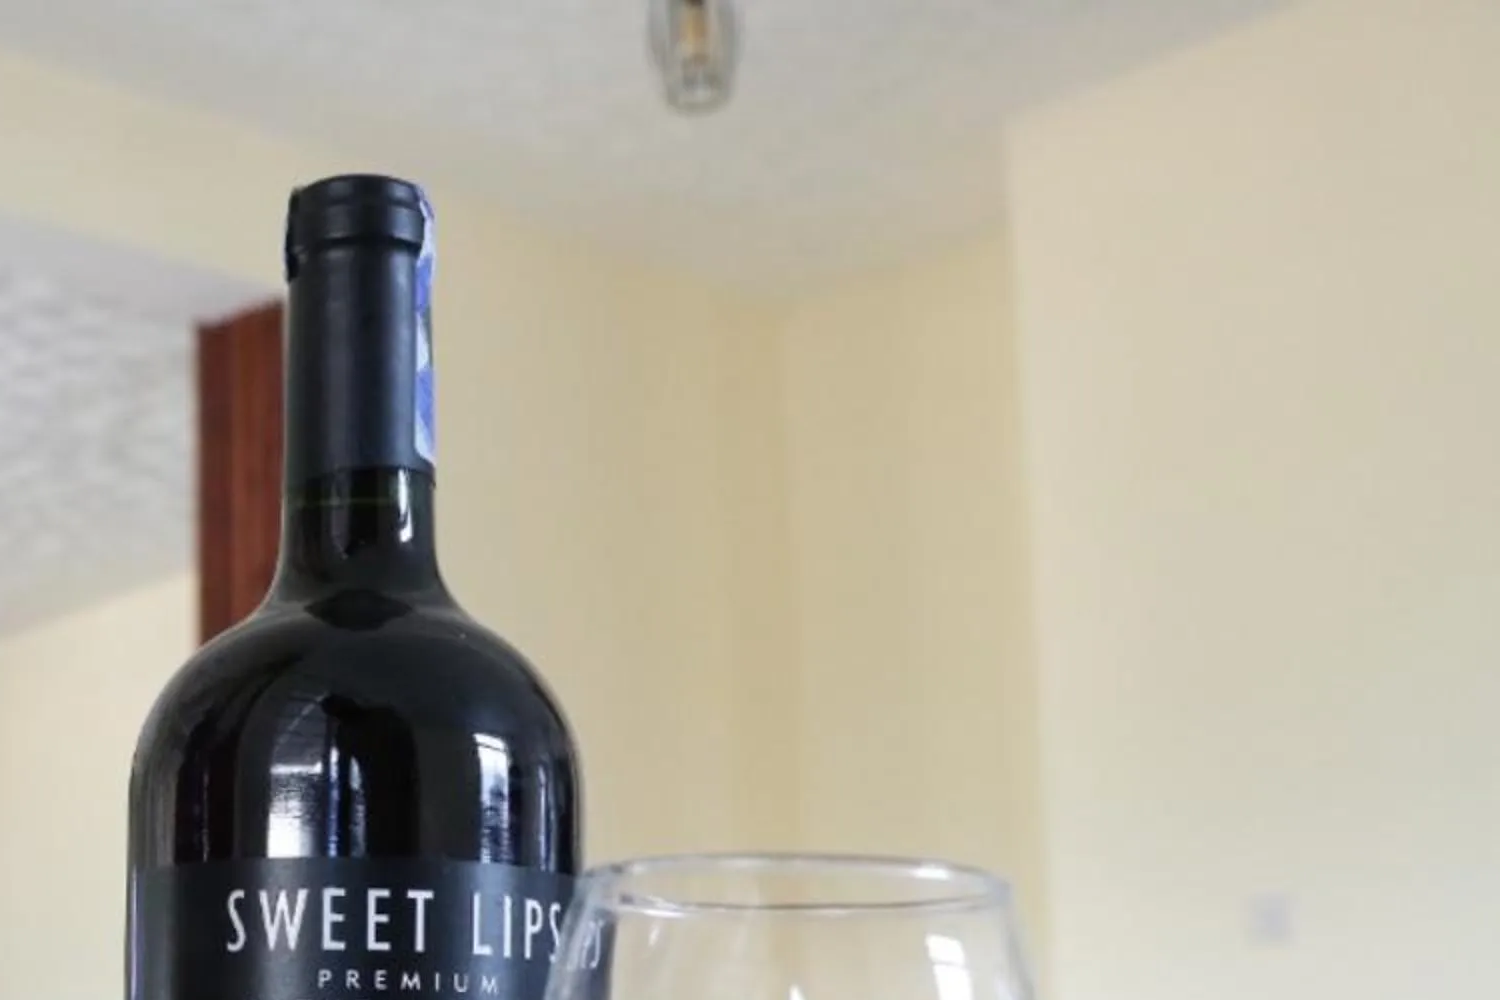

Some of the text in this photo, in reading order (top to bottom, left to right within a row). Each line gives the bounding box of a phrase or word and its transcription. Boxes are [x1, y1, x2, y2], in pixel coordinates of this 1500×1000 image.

[226, 887, 563, 964] SWEET LIPS
[318, 969, 499, 993] PREMIUM
